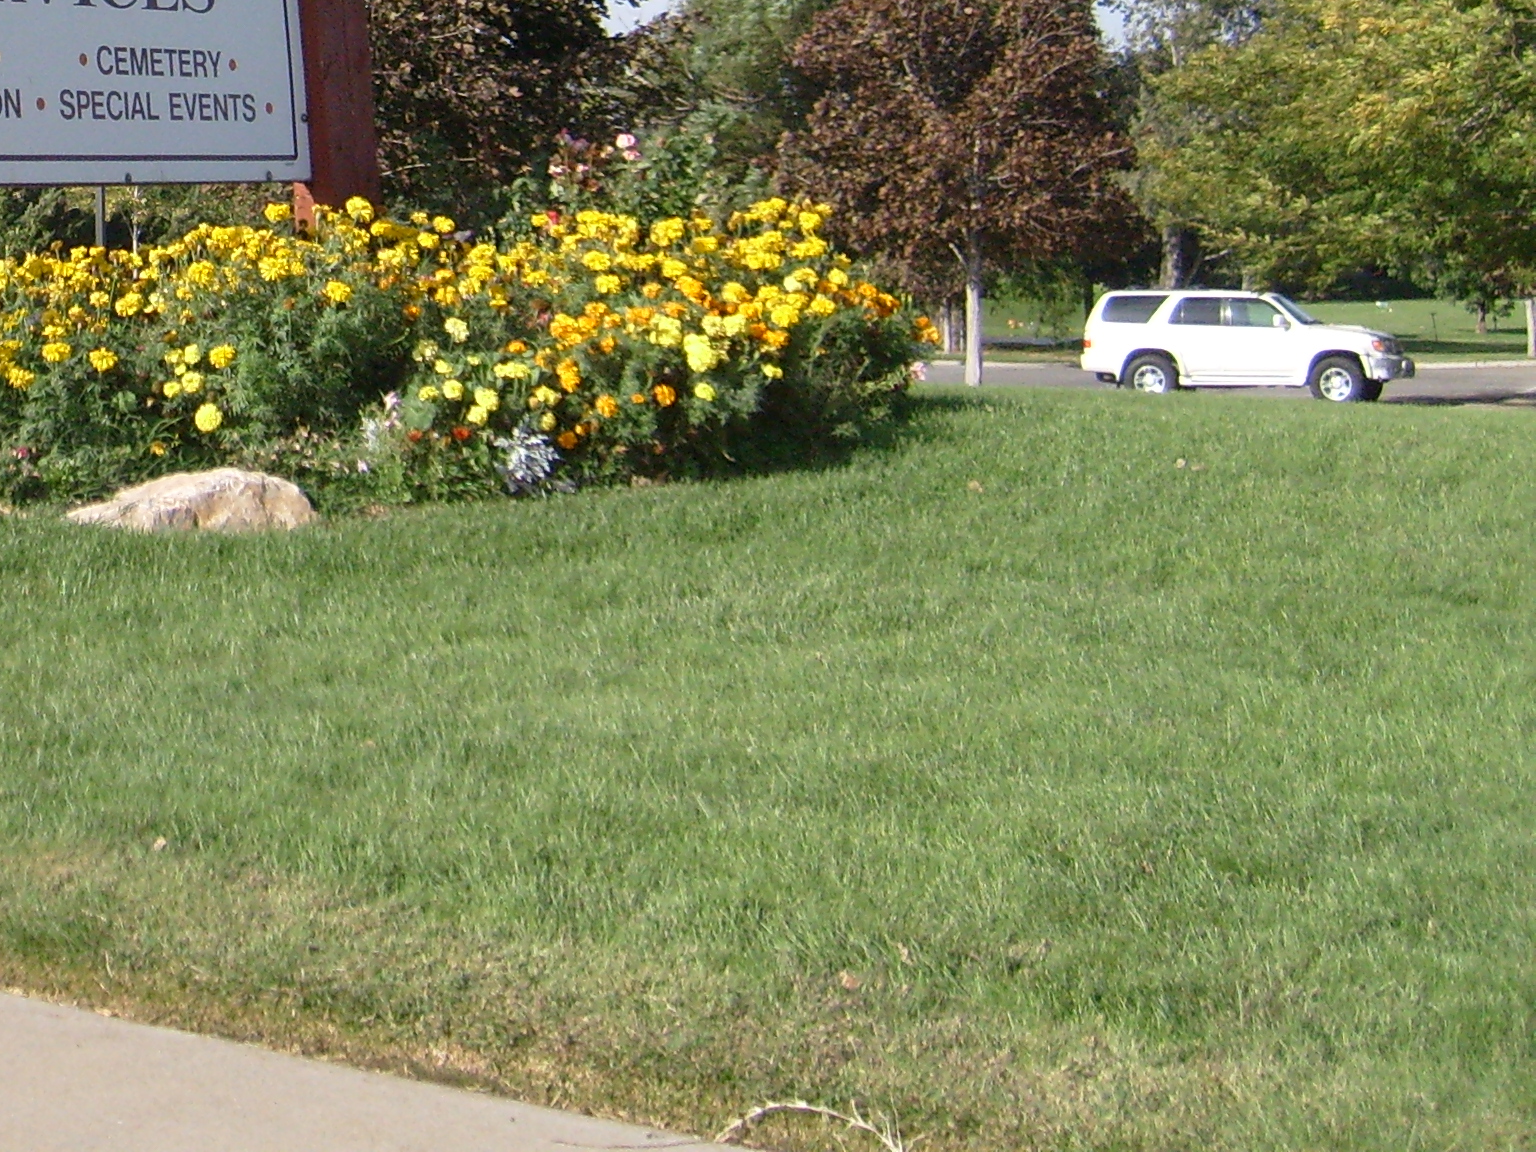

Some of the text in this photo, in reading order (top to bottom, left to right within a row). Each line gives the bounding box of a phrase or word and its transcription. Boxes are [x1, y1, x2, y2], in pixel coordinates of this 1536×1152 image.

[96, 46, 222, 79] CEMETERY
[59, 89, 257, 123] SPECIAL EVENTS
